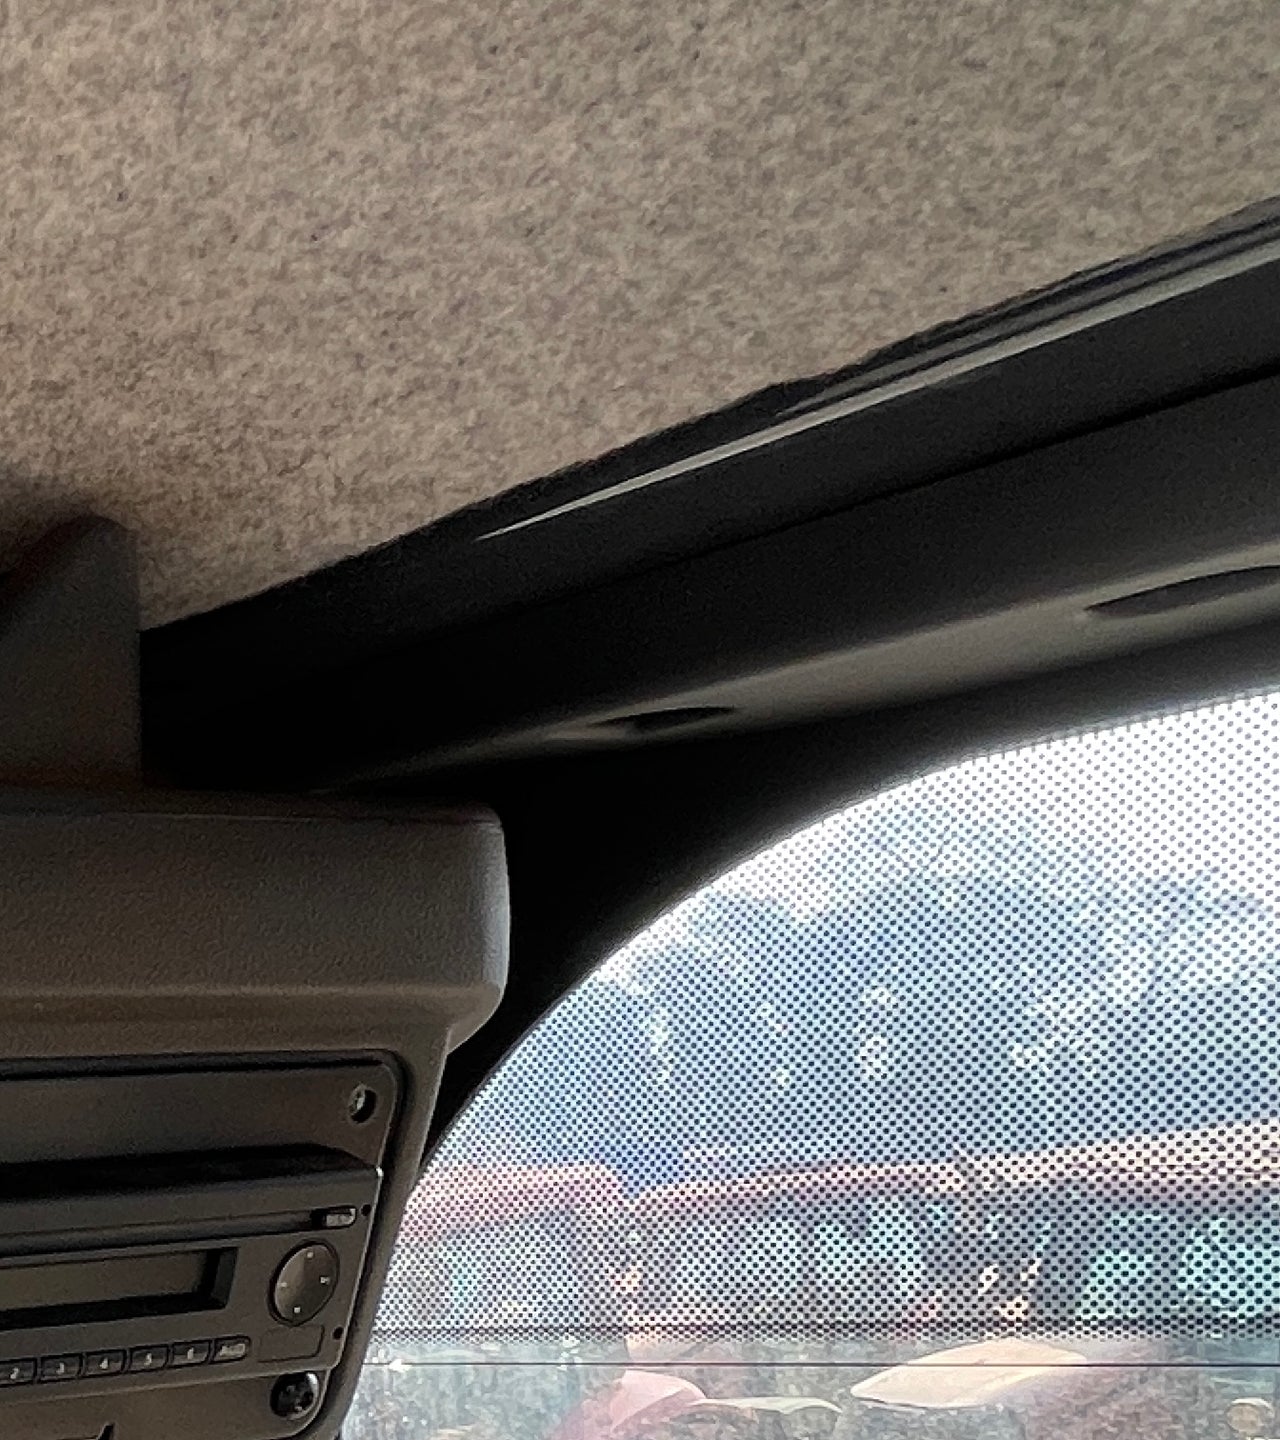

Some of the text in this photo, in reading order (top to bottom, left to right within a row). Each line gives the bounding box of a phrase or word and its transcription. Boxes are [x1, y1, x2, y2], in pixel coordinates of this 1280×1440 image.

[9, 1367, 20, 1379] 2
[56, 1362, 65, 1375] 3
[99, 1357, 109, 1370] 4
[144, 1352, 153, 1366] 5
